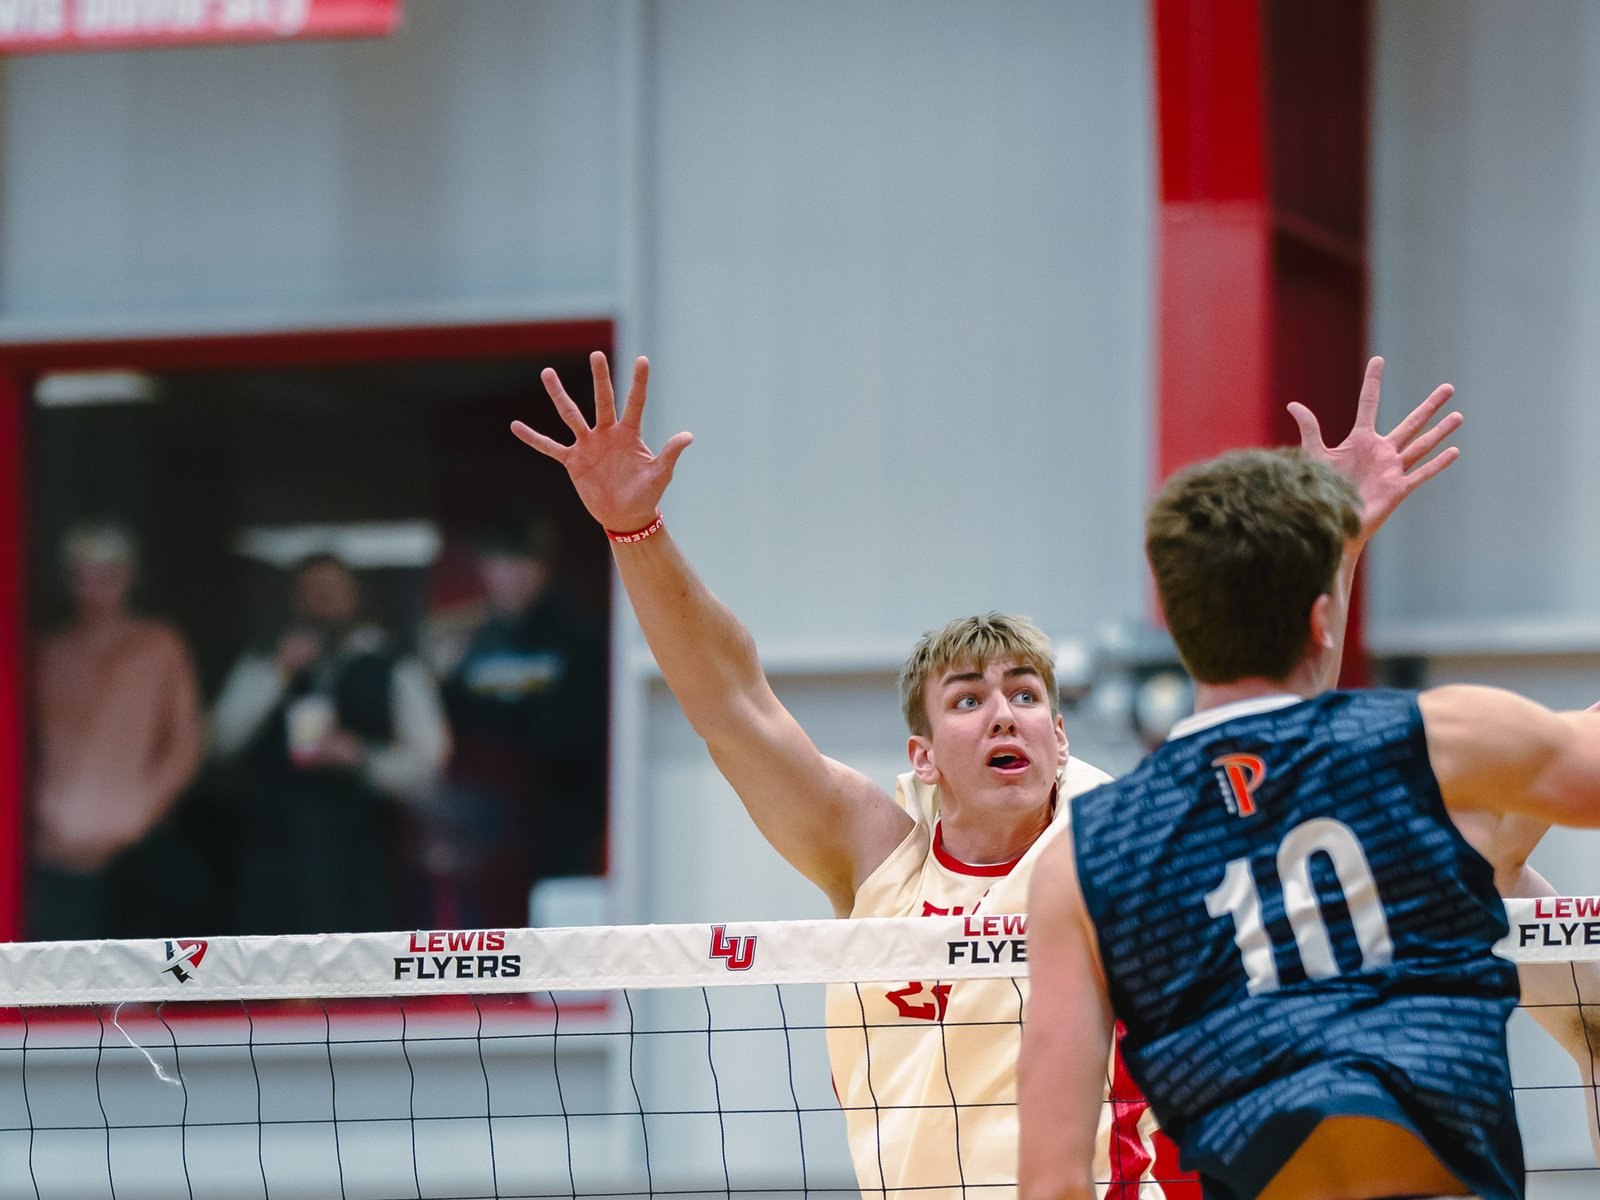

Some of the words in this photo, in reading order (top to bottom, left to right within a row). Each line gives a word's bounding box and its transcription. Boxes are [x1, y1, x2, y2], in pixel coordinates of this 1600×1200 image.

[1211, 752, 1267, 818] P
[1203, 816, 1395, 997] 10
[1535, 898, 1600, 919] LEW
[963, 916, 1028, 937] LEW
[1518, 922, 1600, 947] FLYE
[409, 931, 506, 952] LEWIS
[709, 925, 757, 971] LU
[947, 939, 1028, 965] FLYE
[393, 955, 521, 980] FLYERS
